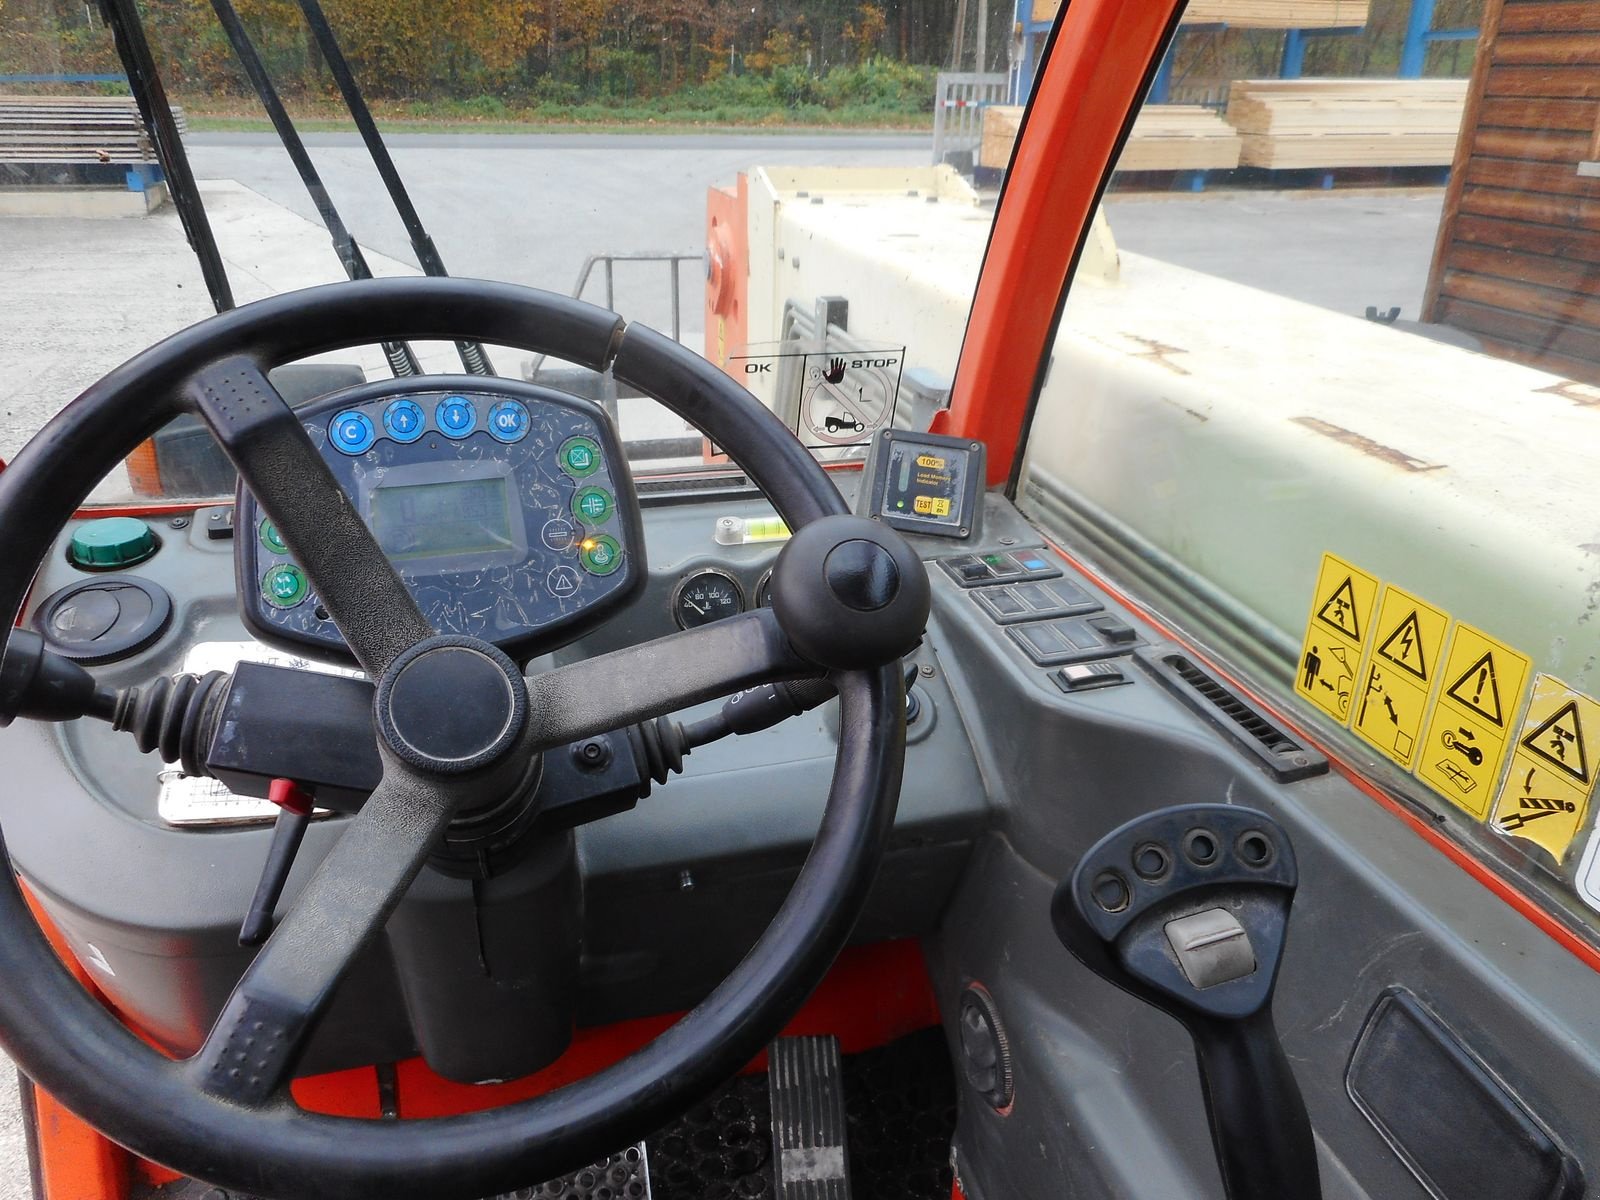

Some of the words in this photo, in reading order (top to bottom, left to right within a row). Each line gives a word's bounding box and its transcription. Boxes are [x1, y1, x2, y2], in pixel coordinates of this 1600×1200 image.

[744, 363, 772, 374] OK
[851, 358, 898, 369] STOP
[499, 413, 516, 428] OK
[345, 425, 357, 439] C
[916, 499, 931, 509] TEST
[708, 591, 720, 599] 100
[720, 597, 732, 605] 120
